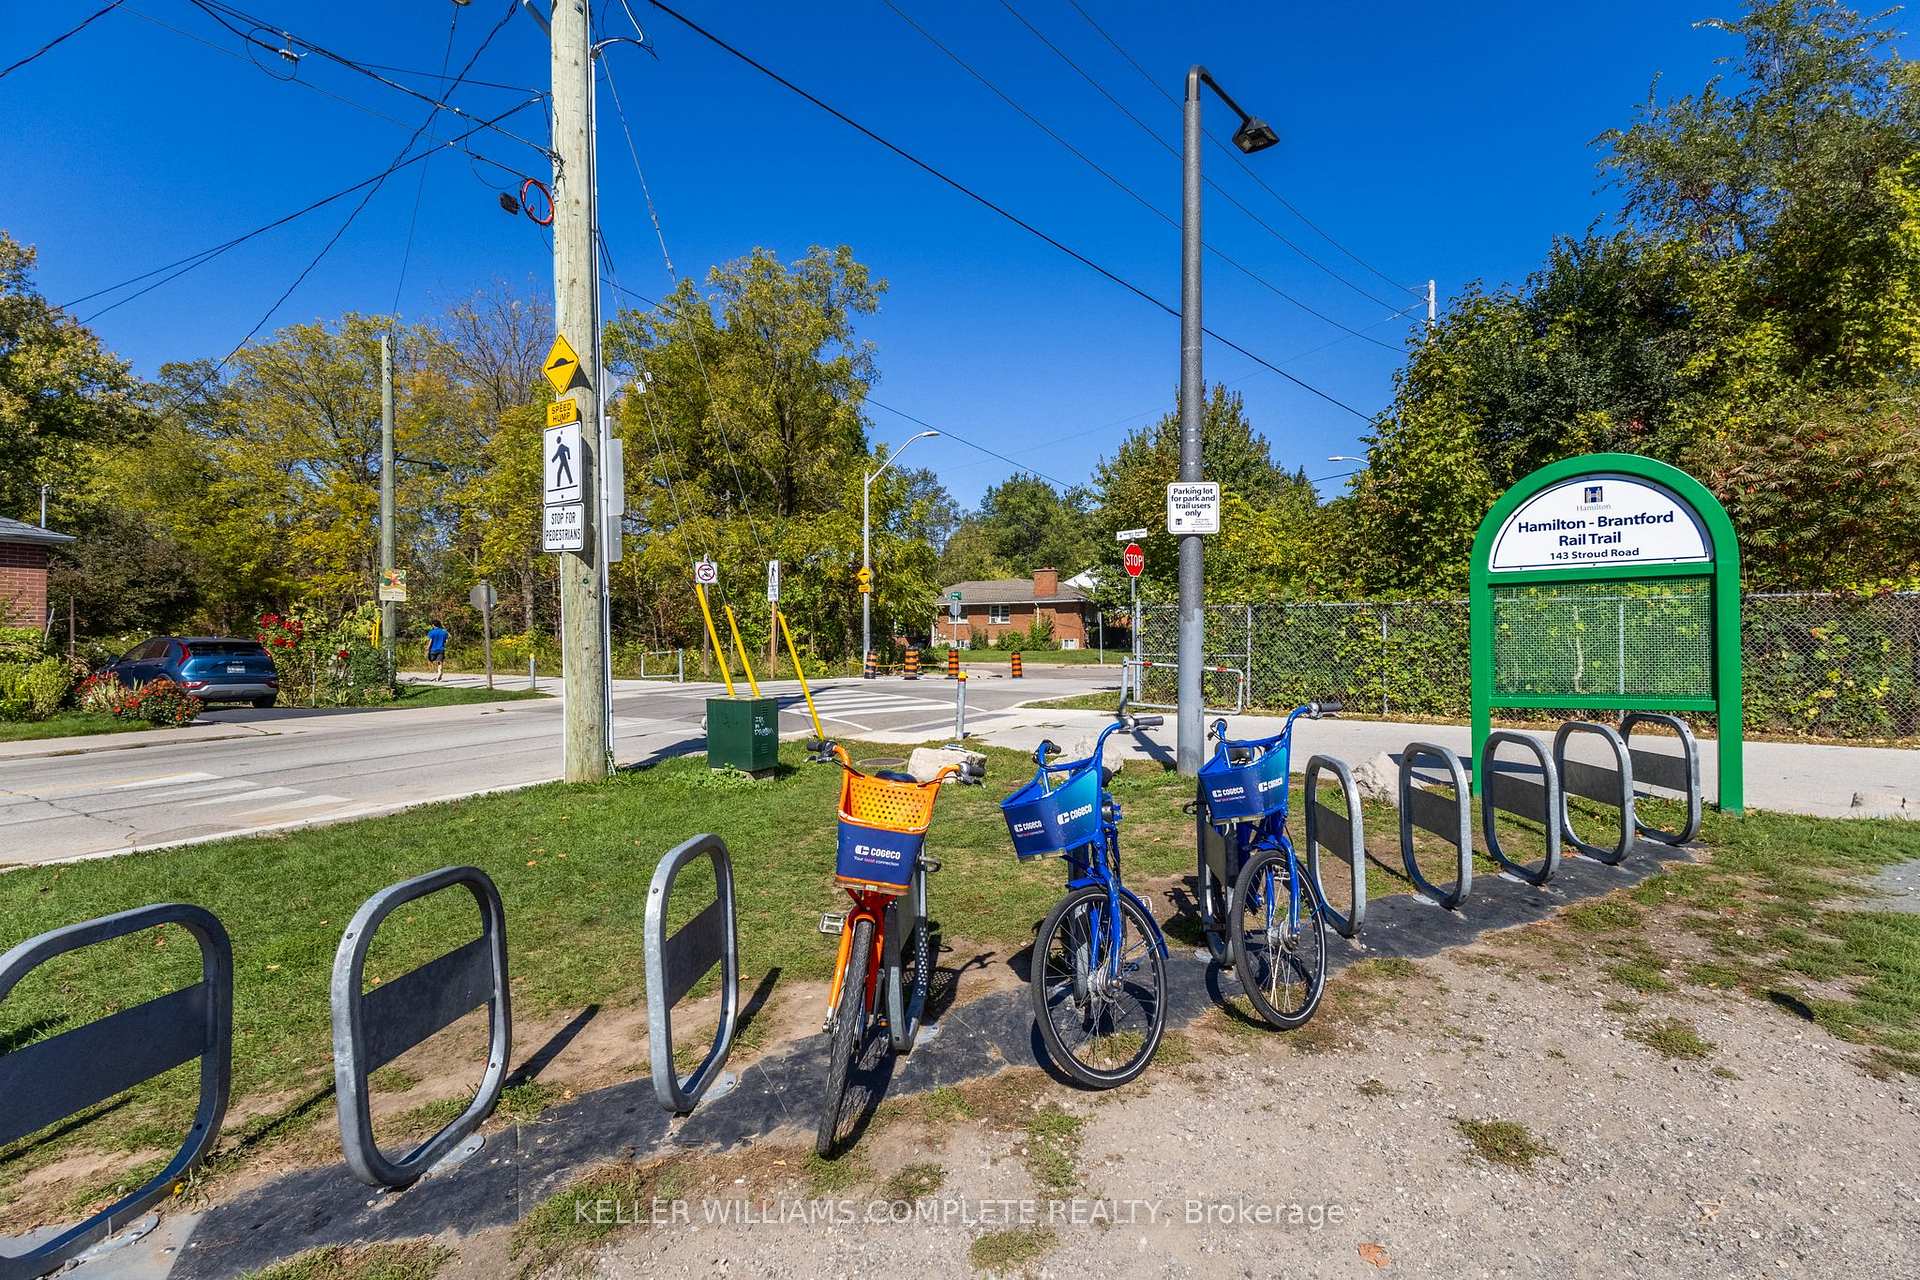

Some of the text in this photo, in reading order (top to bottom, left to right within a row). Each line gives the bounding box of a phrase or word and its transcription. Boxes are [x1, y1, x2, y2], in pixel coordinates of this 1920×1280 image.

[551, 403, 572, 415] SPEED
[552, 411, 571, 423] HUMP
[1173, 488, 1202, 496] Parking
[1183, 495, 1200, 503] park
[1576, 503, 1612, 512] Hamilton
[551, 512, 576, 525] STOP FOR
[1185, 510, 1202, 518] only
[1518, 518, 1586, 533] Hamilton
[1597, 510, 1674, 527] Brantford
[545, 528, 581, 542] PEDESTRIANS
[1559, 531, 1622, 547] Rail Trail
[1550, 548, 1640, 560] 143 Stroud Road
[1125, 554, 1143, 567] STOP
